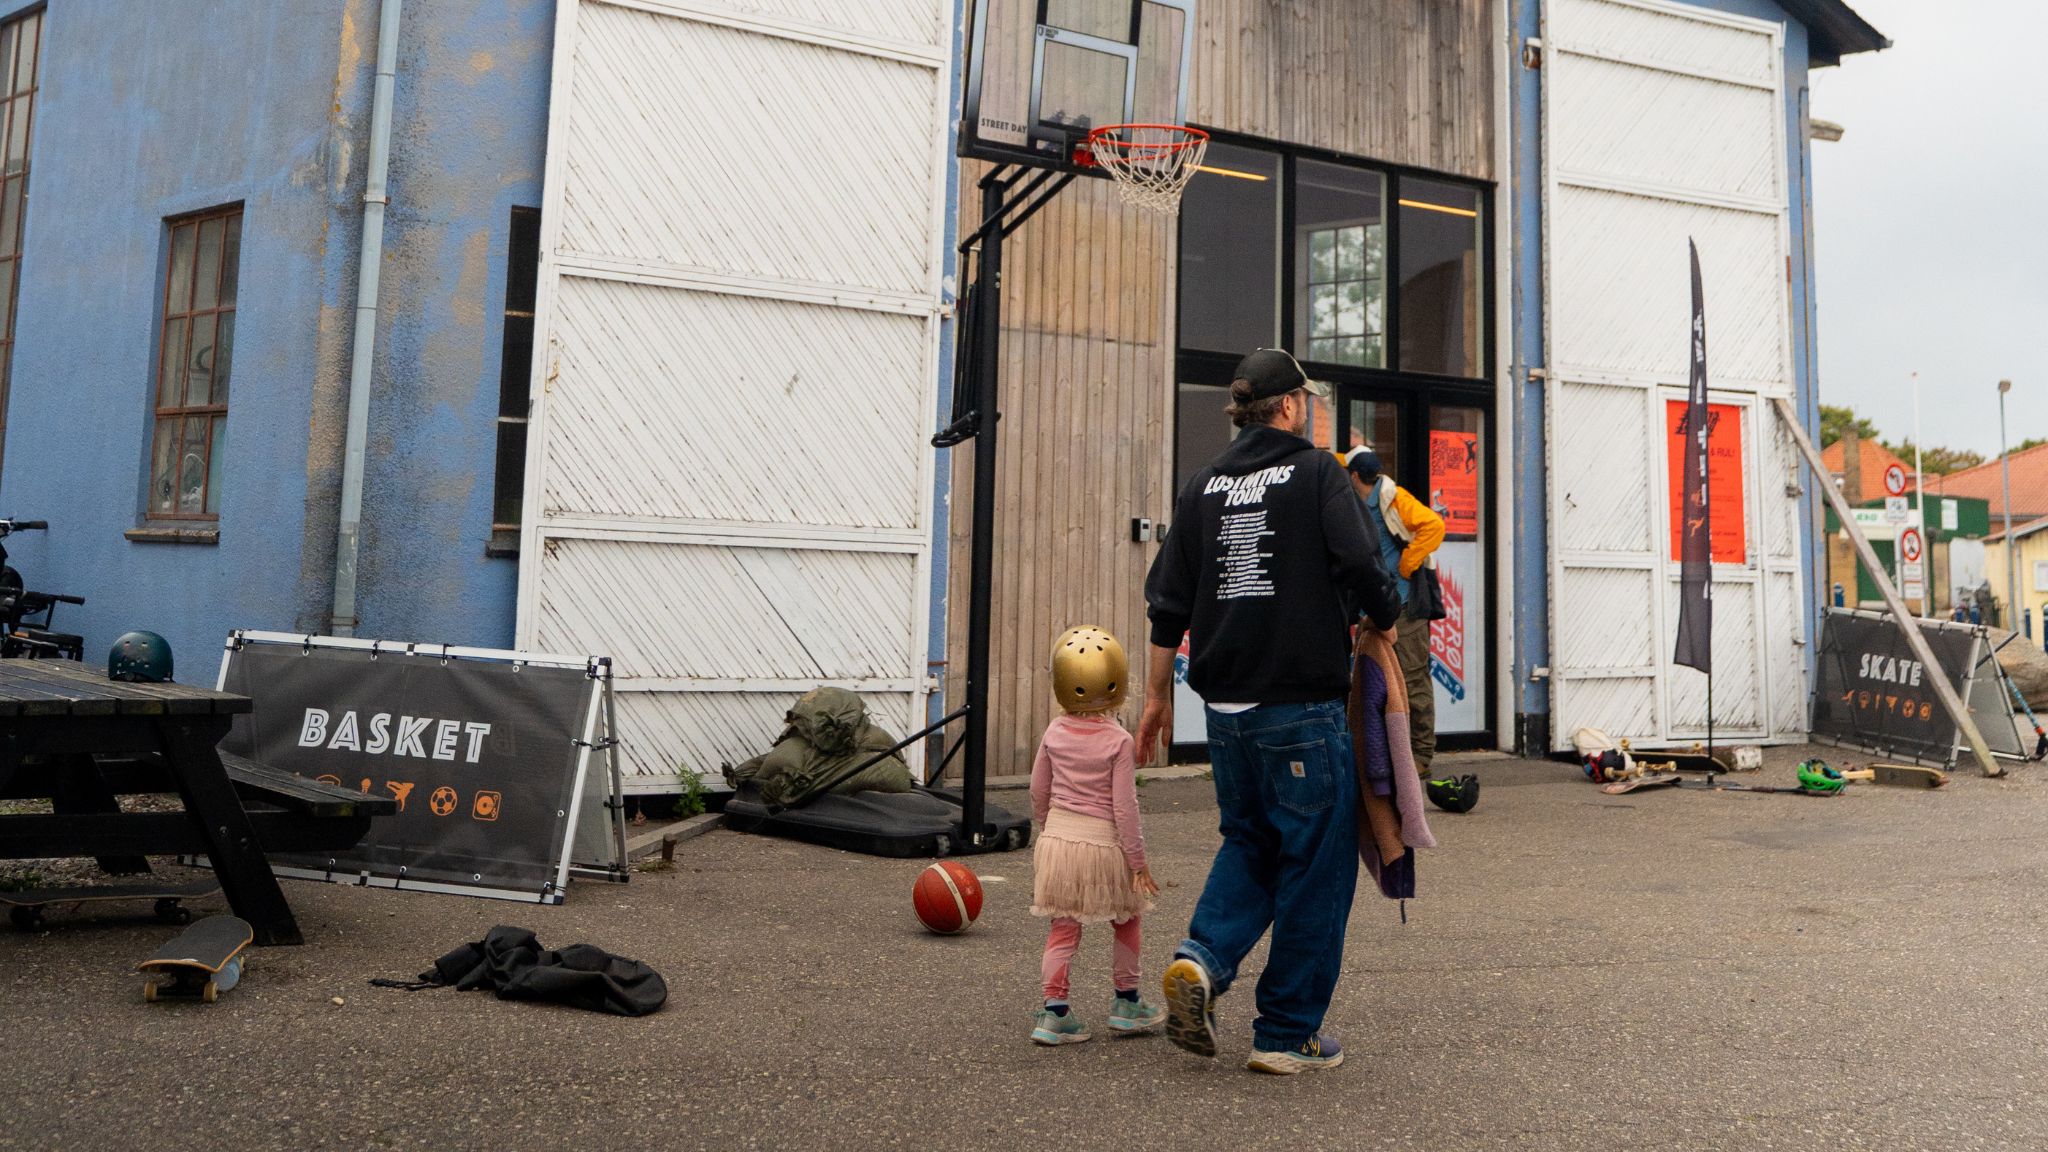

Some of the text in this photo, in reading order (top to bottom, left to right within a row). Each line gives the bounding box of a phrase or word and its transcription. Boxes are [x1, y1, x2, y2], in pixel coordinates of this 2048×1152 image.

[981, 117, 1027, 133] STREET DAY
[1224, 485, 1267, 507] TOUR
[1859, 653, 1922, 687] SKATE
[298, 707, 491, 763] BASKET
